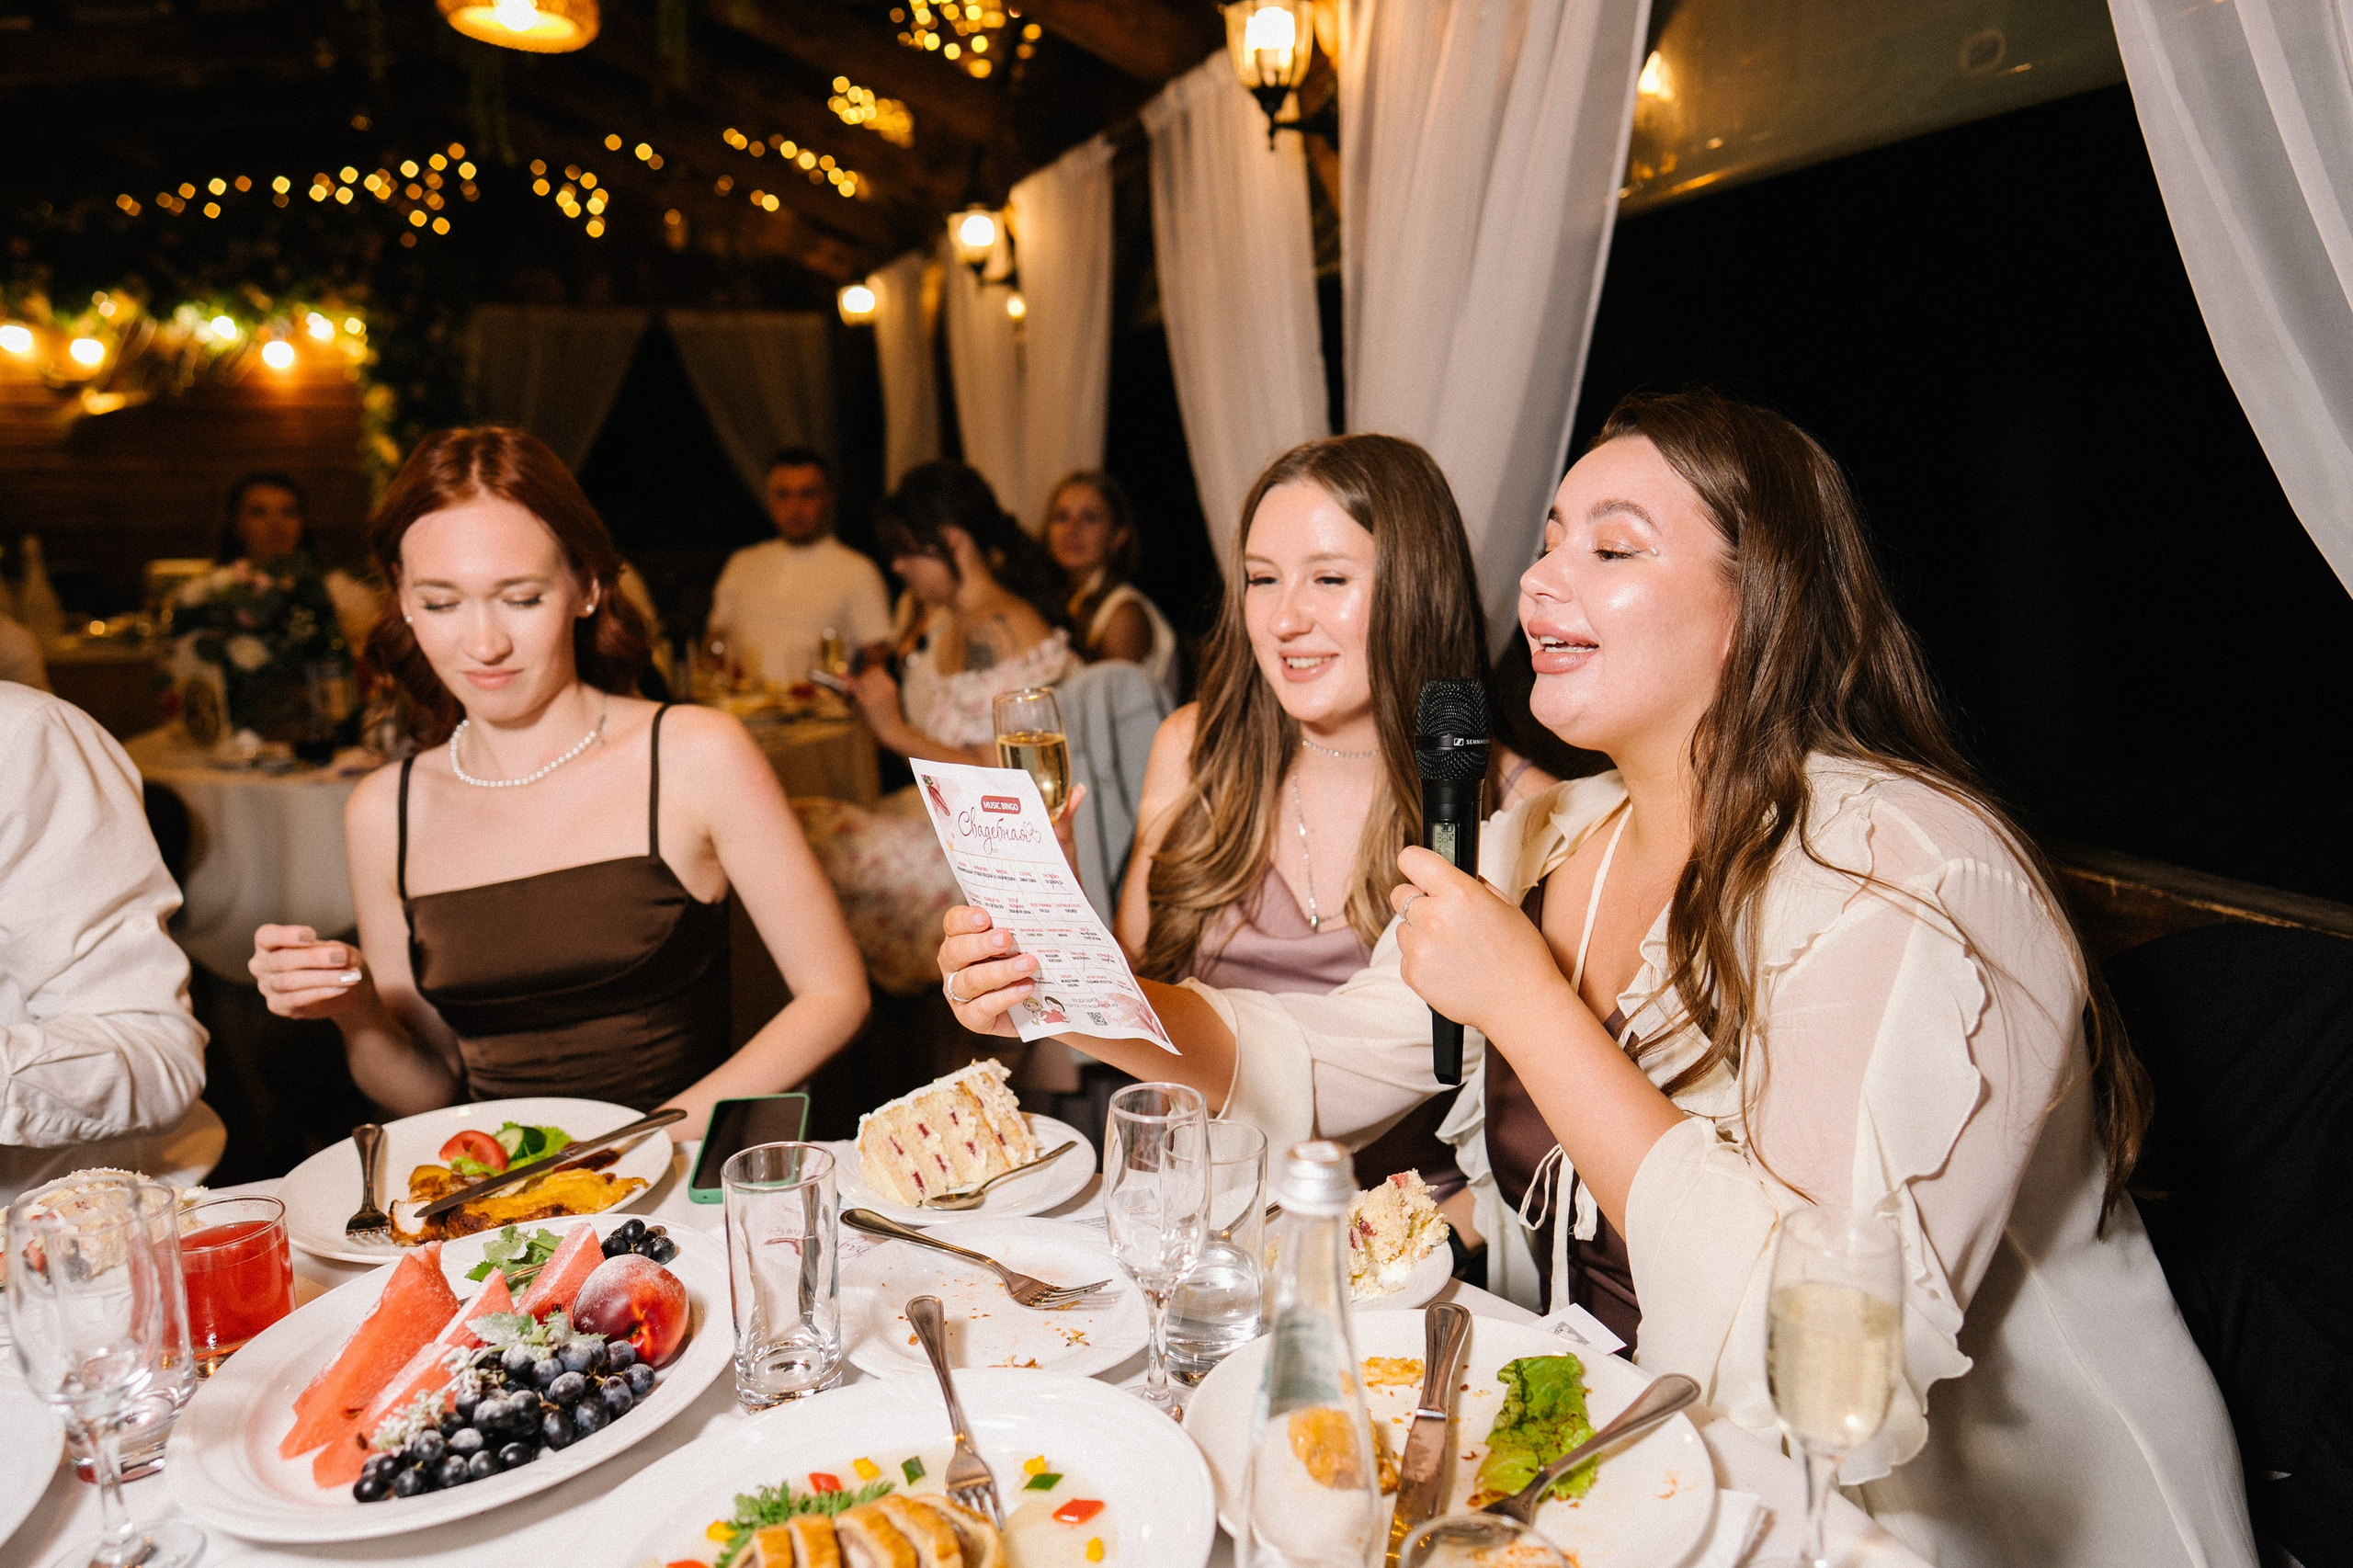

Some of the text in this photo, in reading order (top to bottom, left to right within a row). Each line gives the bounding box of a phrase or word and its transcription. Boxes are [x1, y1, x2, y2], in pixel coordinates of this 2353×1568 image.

[983, 801, 1019, 812] MUSIC BINGO
[958, 806, 1031, 855] Свадебная
